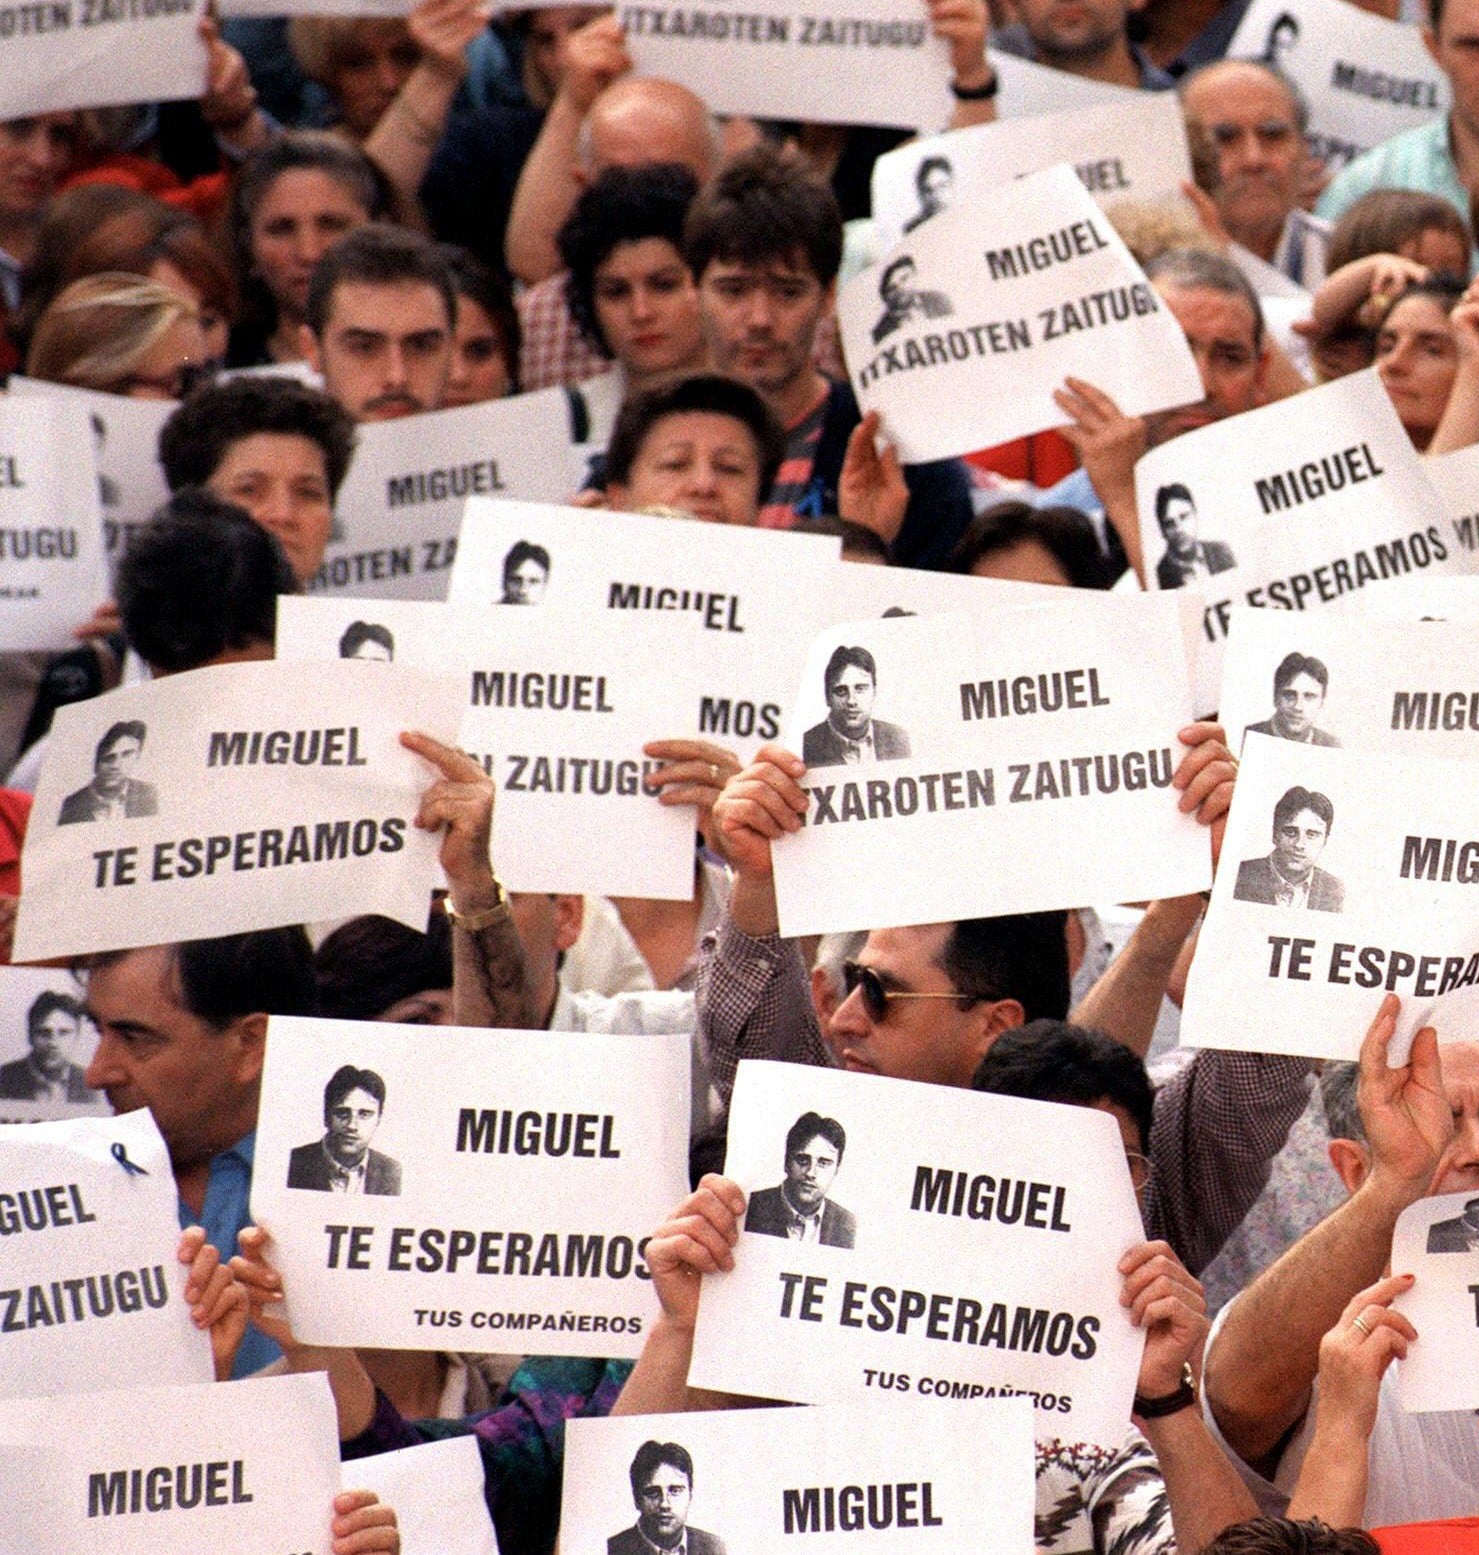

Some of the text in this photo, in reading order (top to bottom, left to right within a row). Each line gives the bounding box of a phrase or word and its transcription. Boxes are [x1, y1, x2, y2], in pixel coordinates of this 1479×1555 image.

[621, 8, 926, 47] ITXAROTEN ZAITUGU
[985, 218, 1109, 281] MIGUEL
[387, 459, 505, 508] MIGUEL
[1254, 443, 1384, 515] MIGUEL
[471, 671, 614, 713] MIGUEL
[960, 668, 1110, 721] MIGUEL
[206, 727, 367, 768] MIGUEL
[1008, 748, 1174, 804] ZAITUGU
[93, 817, 407, 888] TE ESPERAMOS
[1267, 936, 1315, 981] TE
[456, 1108, 621, 1159] MIGUEL
[910, 1165, 1072, 1233] MIGUEL
[325, 1225, 374, 1270] TE
[2, 1265, 169, 1333] ZAITUGU
[414, 1309, 643, 1334] TUS COMPAÑEROS
[779, 1272, 1101, 1361] TE ESPERAMOS
[863, 1369, 911, 1392] TUS
[88, 1460, 253, 1517] MIGUEL
[782, 1482, 943, 1534] MIGUEL
